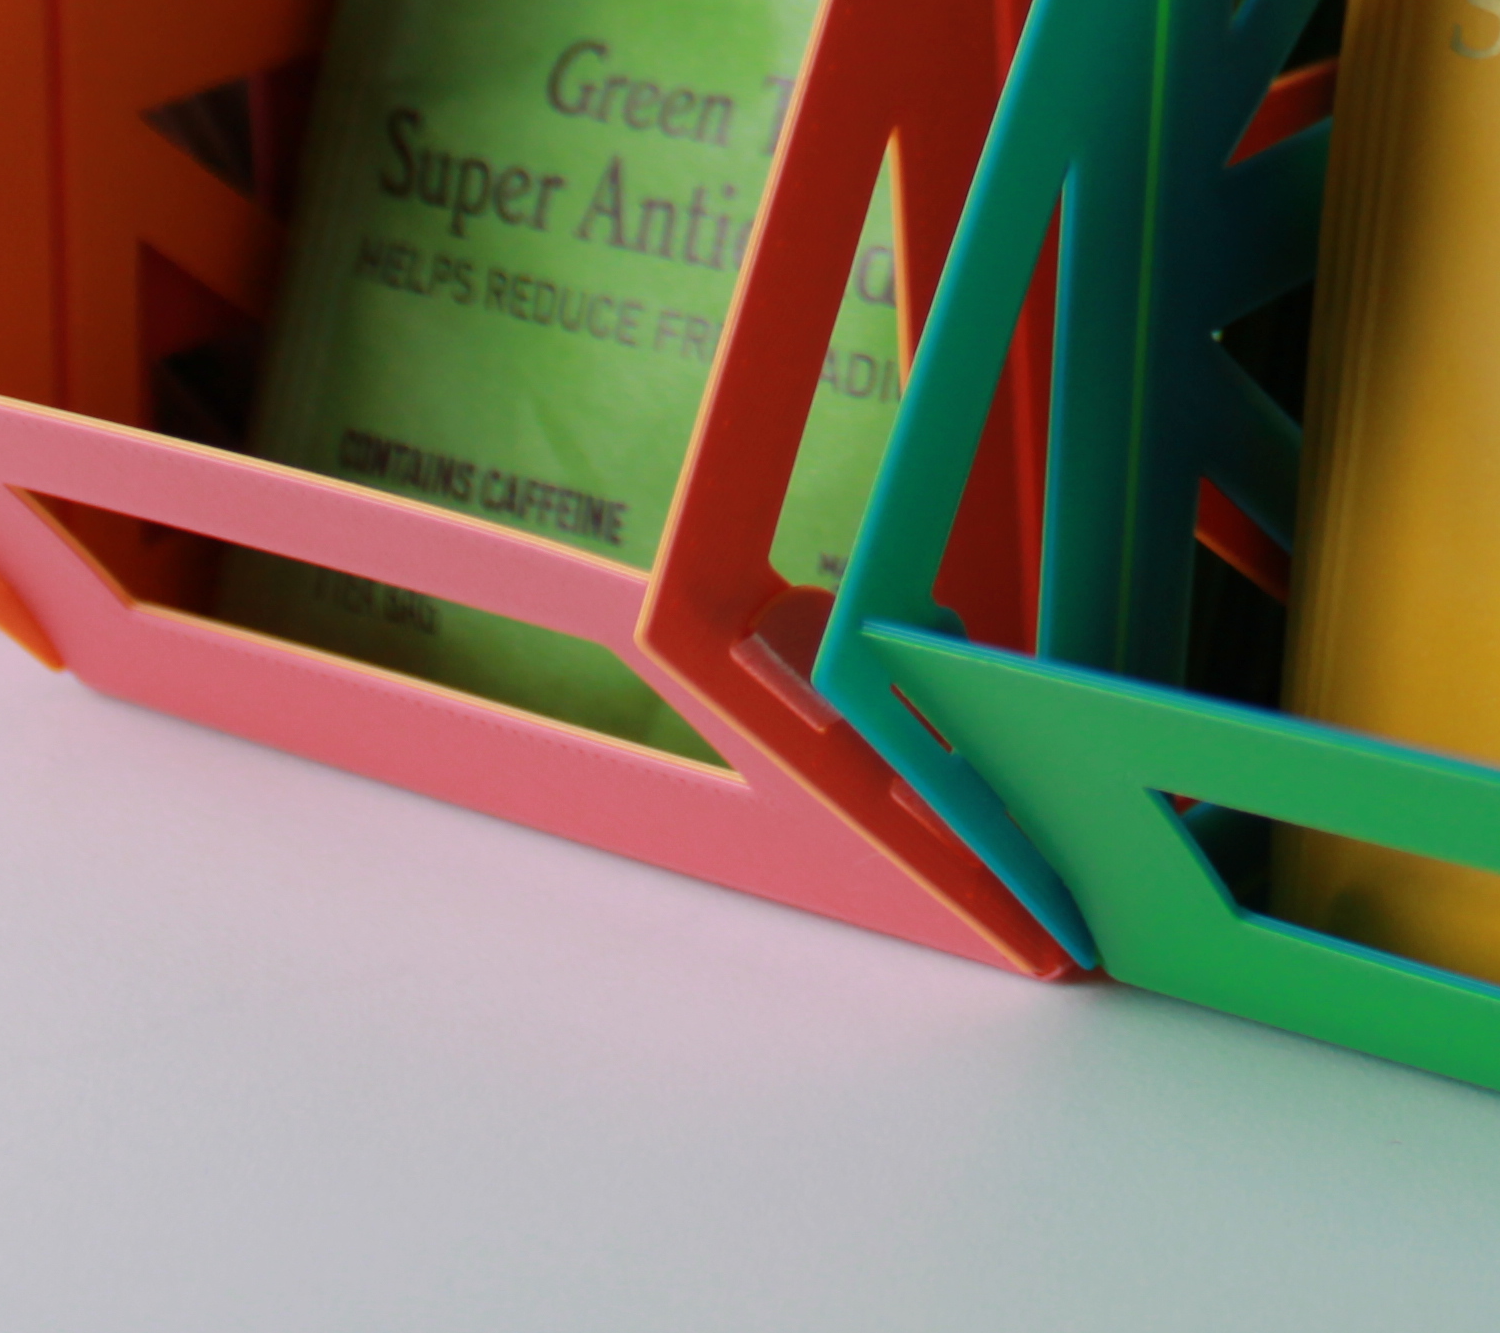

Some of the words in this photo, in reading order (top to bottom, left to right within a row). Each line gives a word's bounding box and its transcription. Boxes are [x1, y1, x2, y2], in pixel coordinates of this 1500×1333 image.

[546, 36, 735, 149] Green
[377, 107, 566, 241] Super
[355, 235, 474, 306] HELPS
[482, 267, 644, 350] REDUCE
[653, 304, 726, 363] FR
[336, 426, 476, 505] CONTAINS
[478, 464, 630, 547] CAFFEINE
